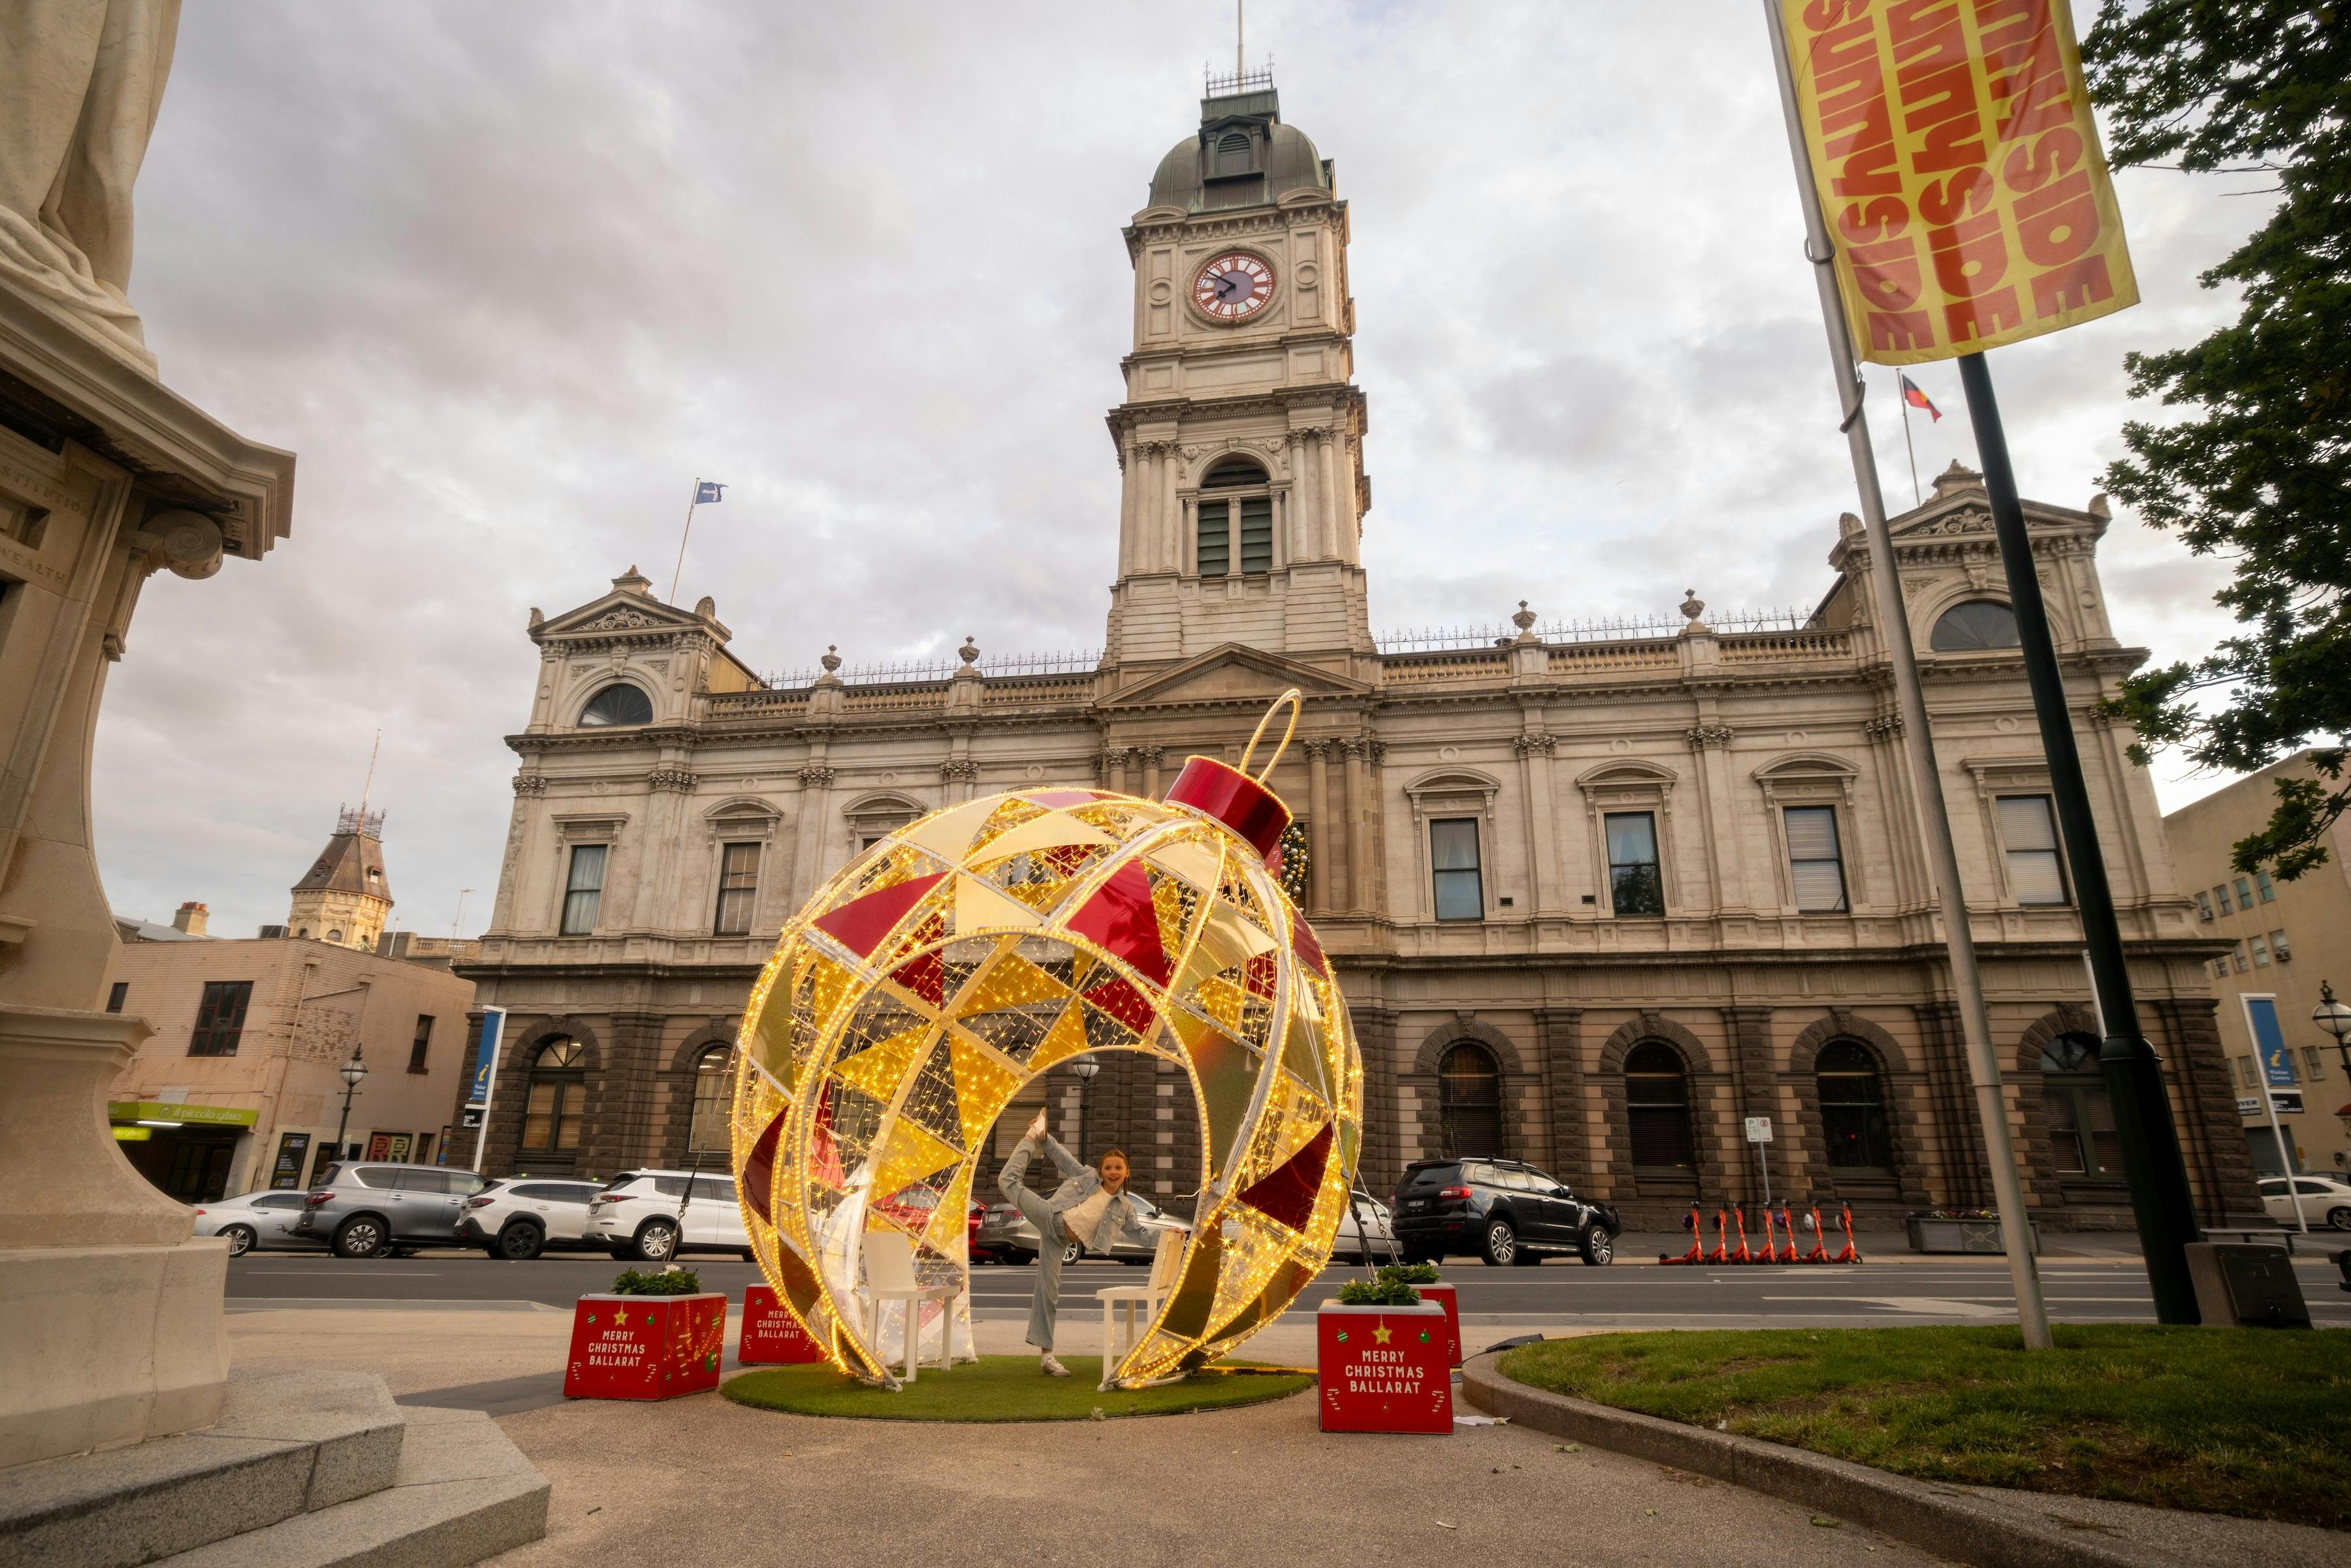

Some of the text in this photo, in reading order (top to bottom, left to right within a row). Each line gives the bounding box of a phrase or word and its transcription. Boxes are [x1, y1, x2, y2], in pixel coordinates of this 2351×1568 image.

[602, 1330, 635, 1341] MERRY
[758, 1330, 800, 1339] BALLARAT
[588, 1342, 645, 1354] CHRISTMAS
[589, 1355, 641, 1367] BALLARAT
[1362, 1350, 1405, 1363] MERRY
[1345, 1365, 1424, 1378] CHRISTMAS
[1350, 1381, 1420, 1394] BALLARAT
